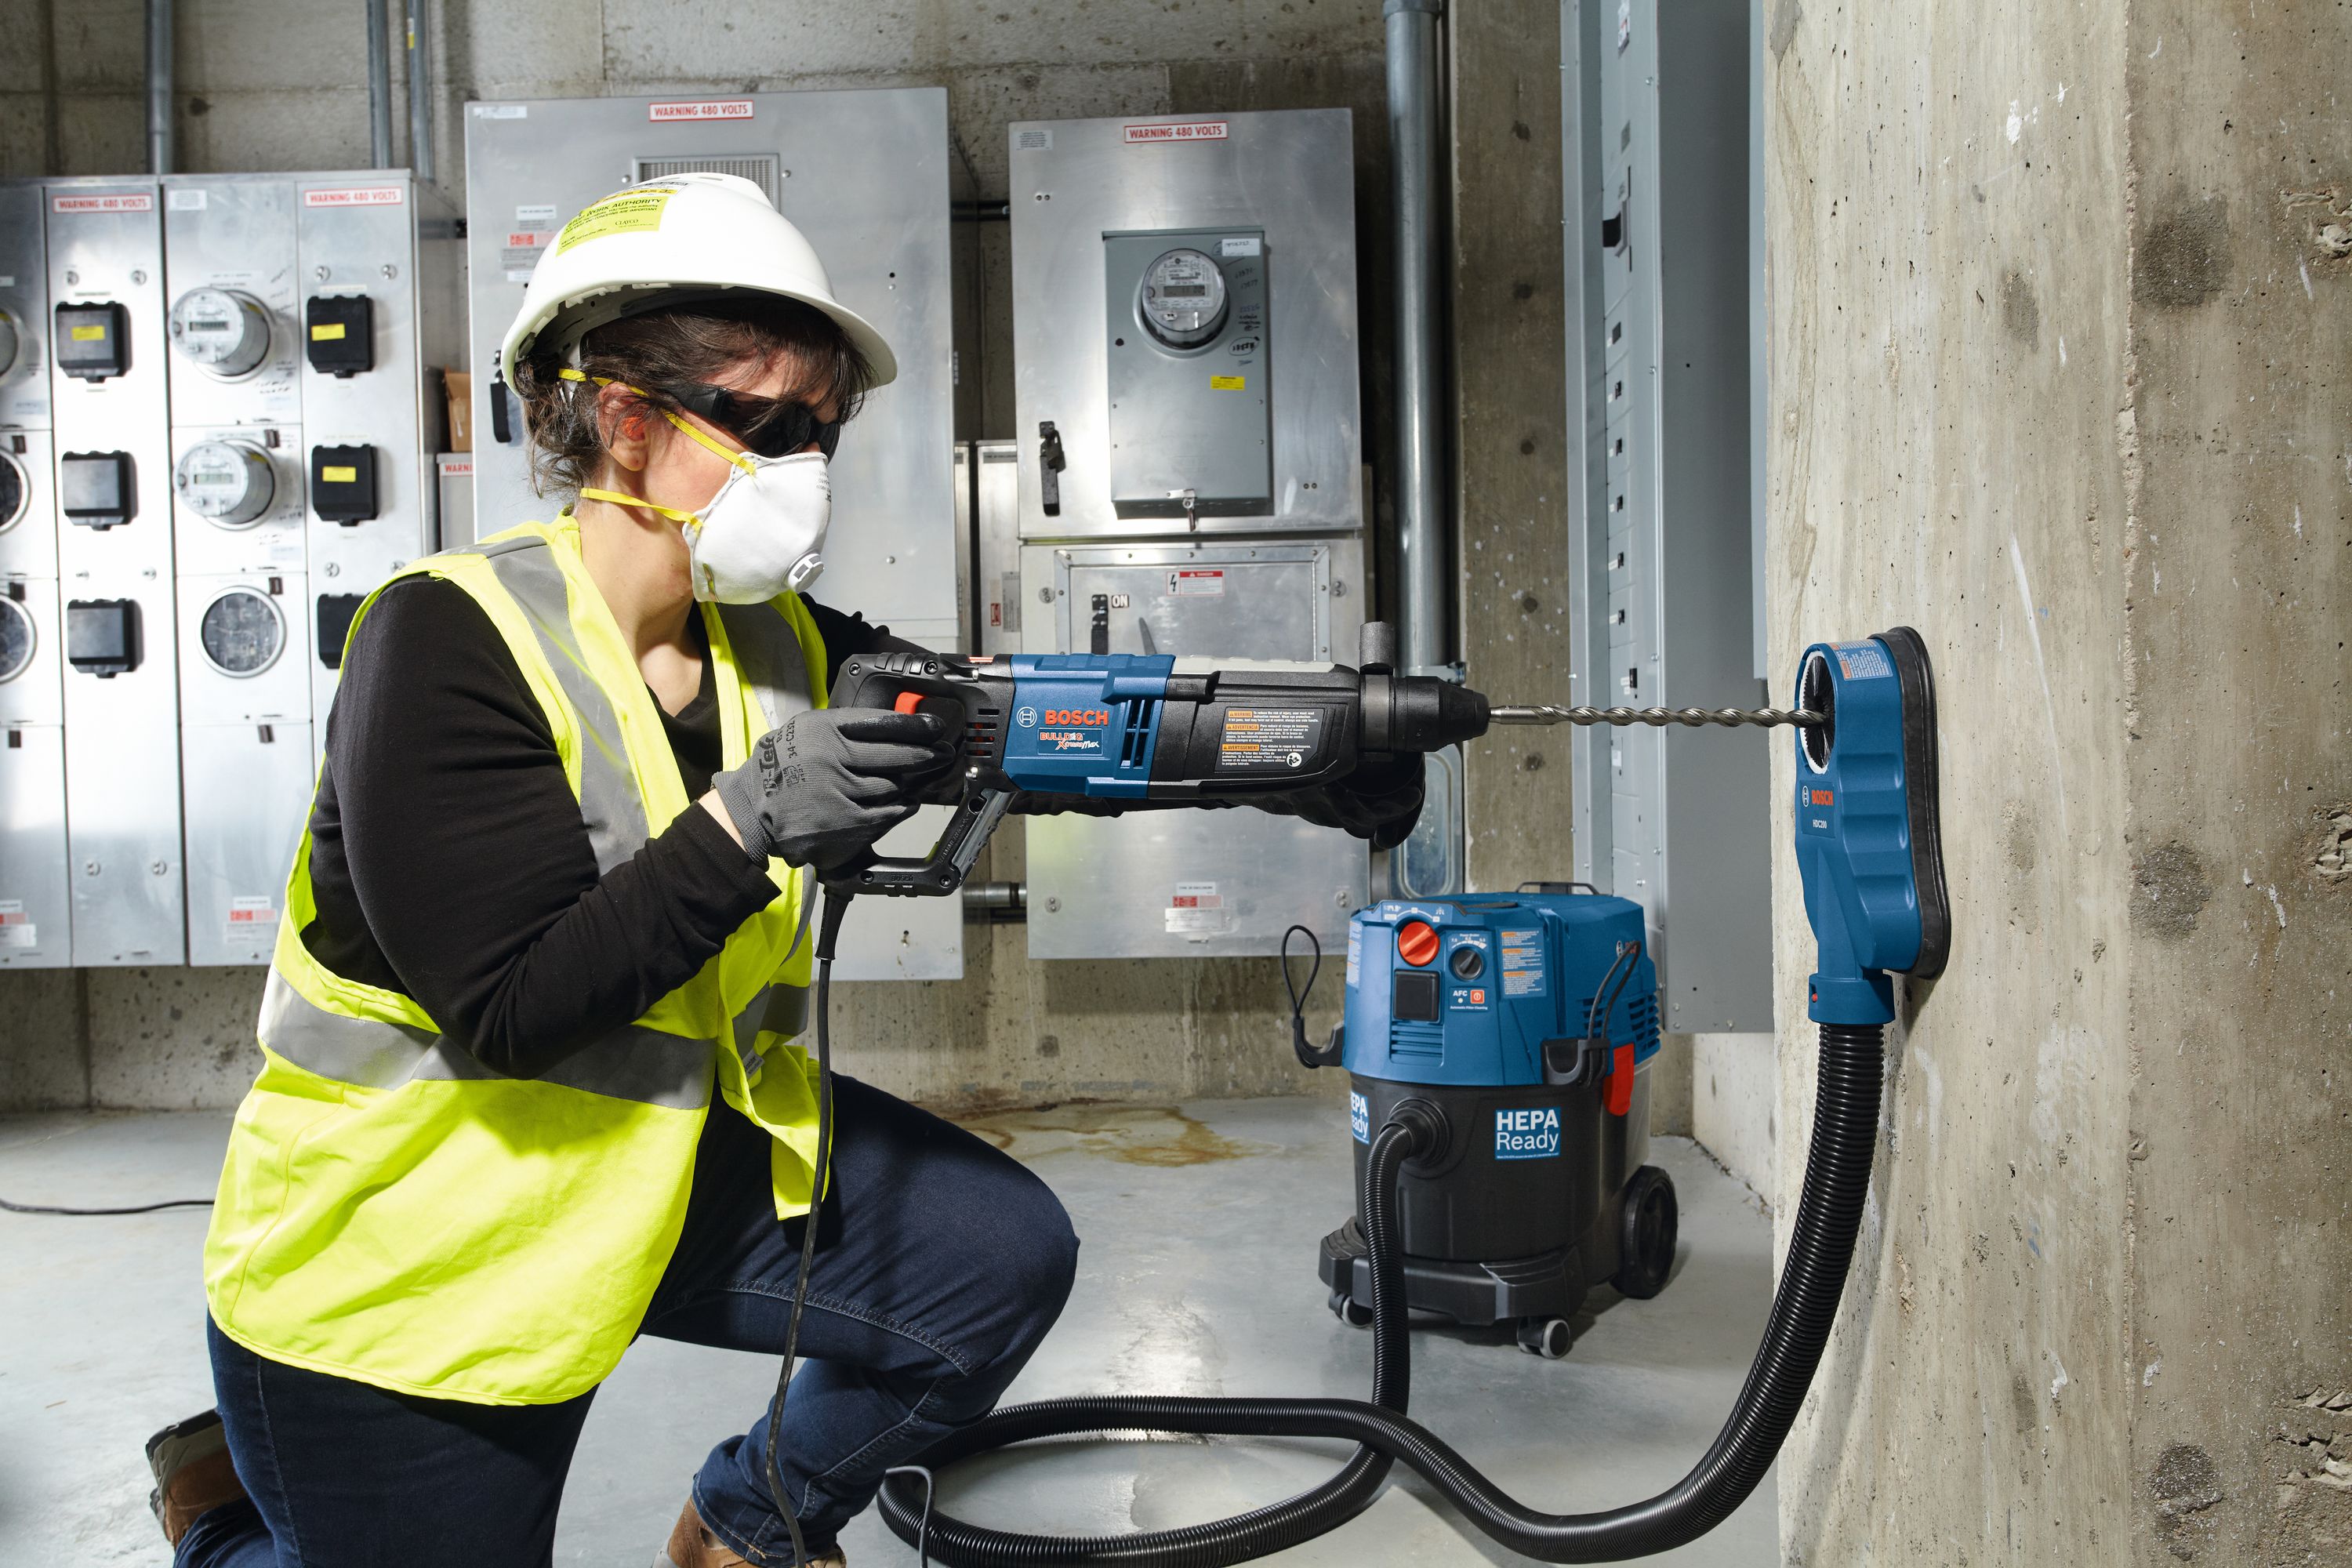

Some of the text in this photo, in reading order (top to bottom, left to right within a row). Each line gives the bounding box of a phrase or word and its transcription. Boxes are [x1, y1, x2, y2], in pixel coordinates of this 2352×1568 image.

[655, 104, 748, 116] WARNING 480 VOLTS
[1129, 125, 1222, 138] WARNING 480 VOLTS
[60, 198, 145, 209] WARNING 480 VOLTS
[310, 191, 397, 203] WARNING 480 VOLTS
[612, 198, 662, 208] AUTHORITY
[1112, 595, 1128, 607] ON
[1045, 710, 1109, 726] BOSCH
[786, 720, 798, 759] 34-C232
[1812, 789, 1834, 806] BOSCH
[1352, 1114, 1368, 1138] eady
[1496, 1109, 1559, 1131] HEPA
[1496, 1129, 1559, 1152] Ready
